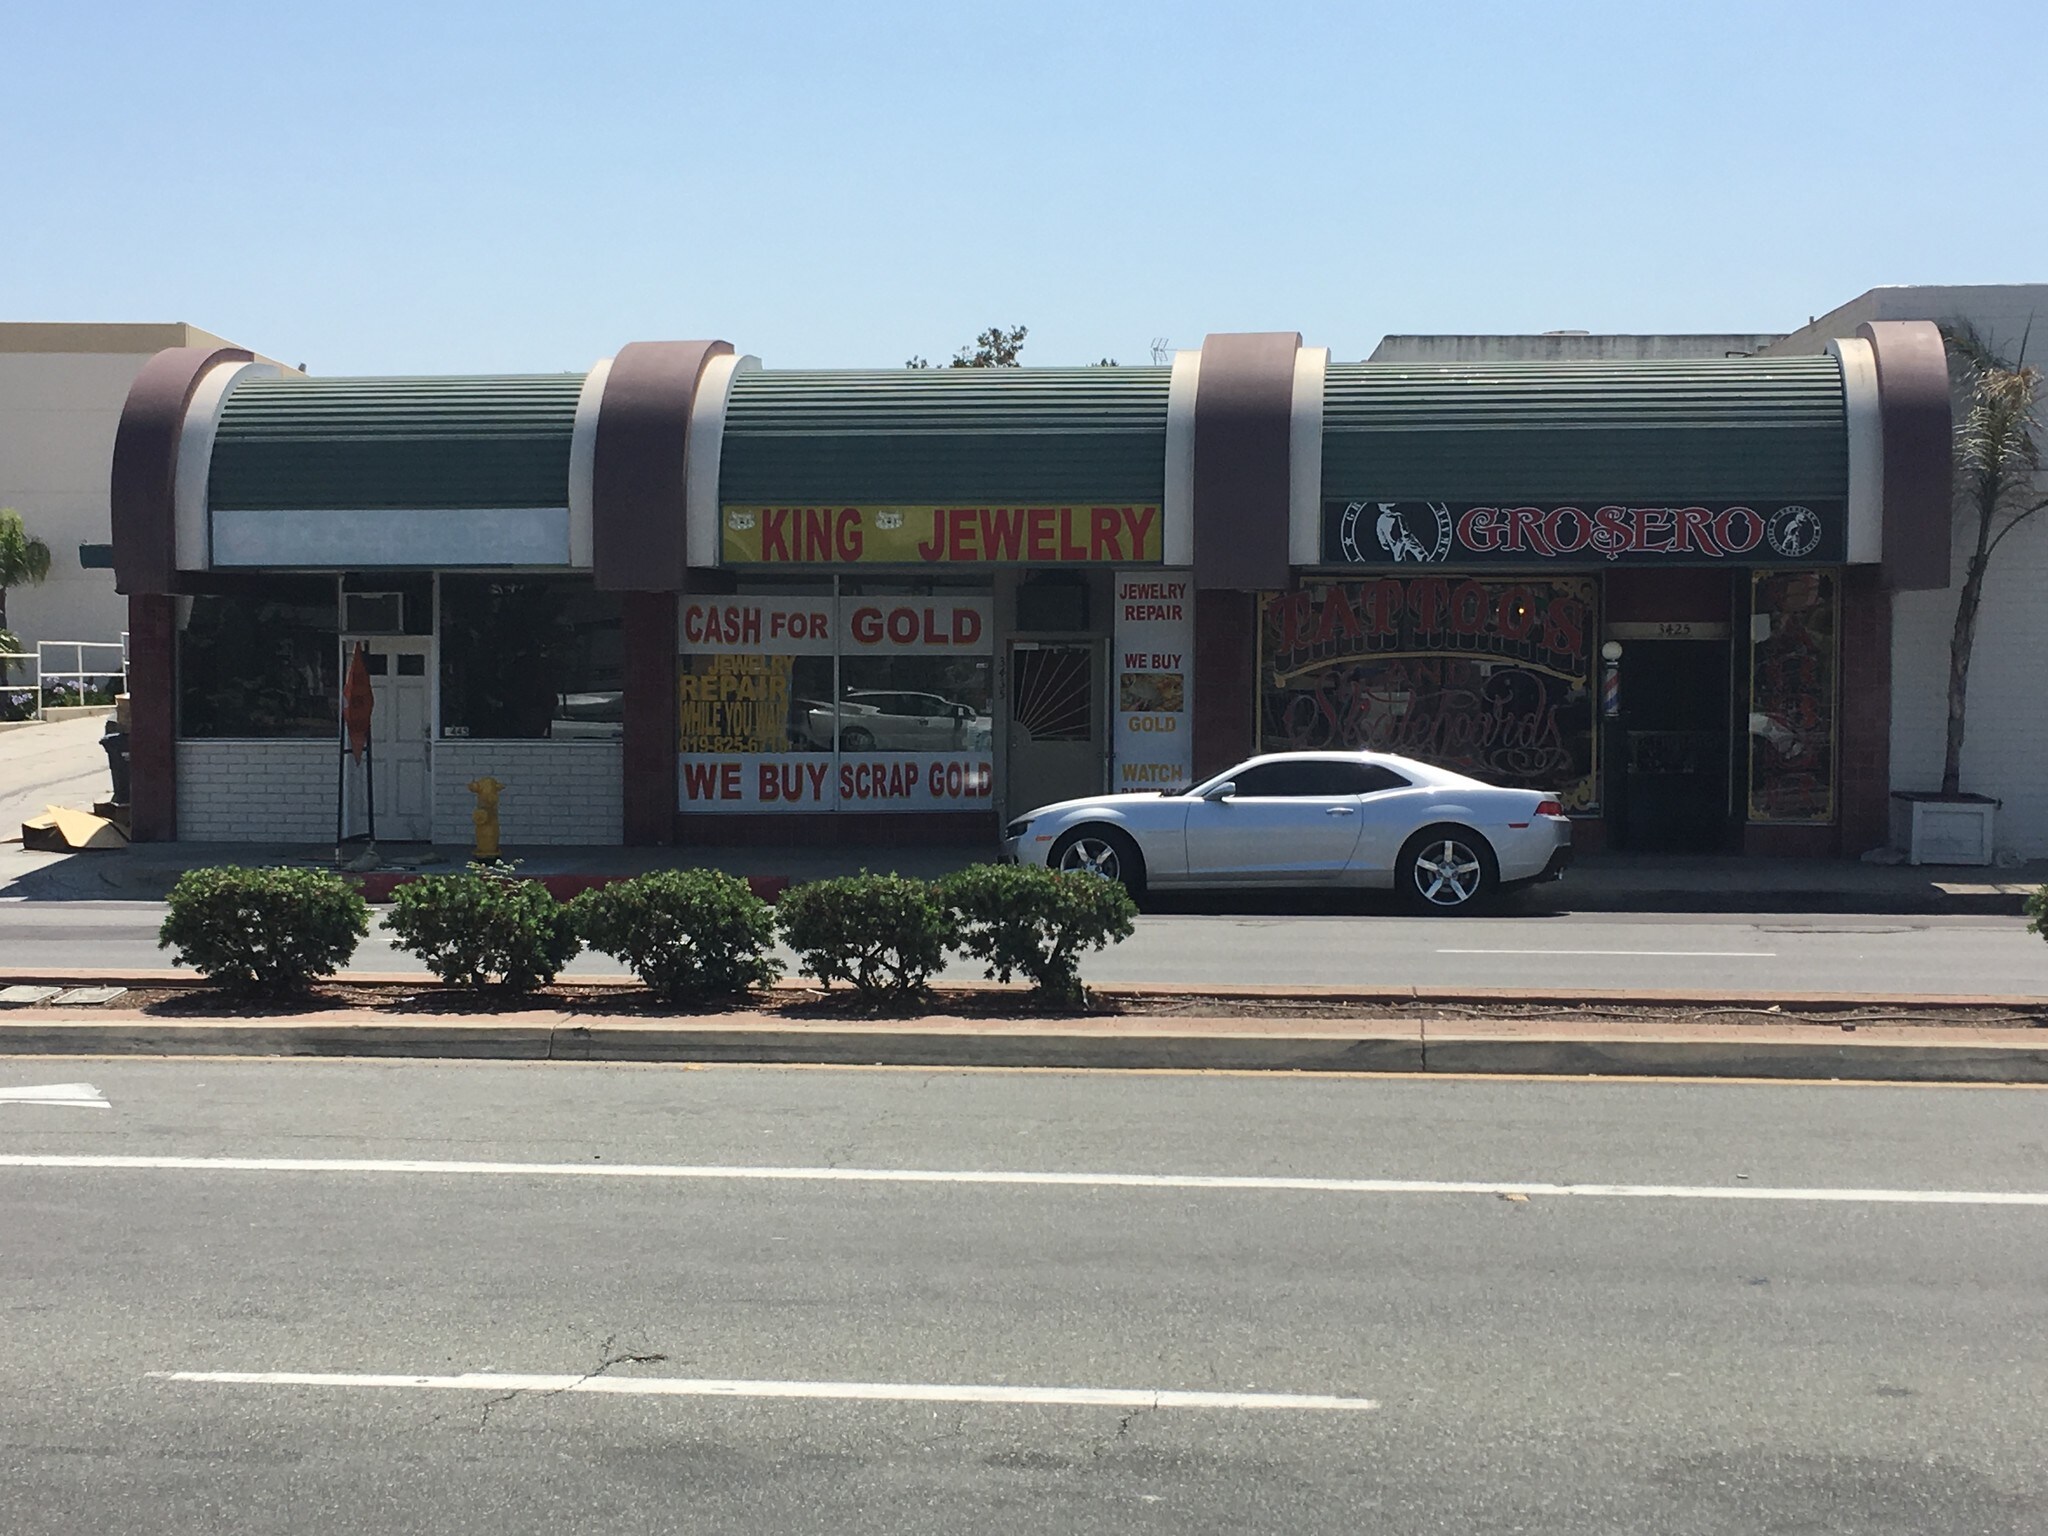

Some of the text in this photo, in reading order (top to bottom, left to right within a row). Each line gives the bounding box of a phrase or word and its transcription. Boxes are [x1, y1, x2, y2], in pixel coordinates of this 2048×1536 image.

[761, 507, 1156, 563] KING JEWELRY
[1457, 505, 1765, 561] GROSERO
[1119, 583, 1187, 600] JEWELRY
[1125, 605, 1183, 621] REPAIR
[1267, 578, 1587, 662] TATTOOS
[685, 606, 982, 645] CASH FOR GOLD
[1659, 623, 1691, 636] 3425
[708, 654, 796, 675] JEWELRY
[1125, 653, 1183, 669] WE BUY
[679, 675, 788, 701] REPAIR
[680, 701, 722, 736] WHILE
[725, 701, 752, 736] YOU
[1128, 716, 1177, 732] GOLD
[684, 761, 993, 801] WE BUY SCRAP GOLD
[1122, 763, 1183, 782] WATCH
